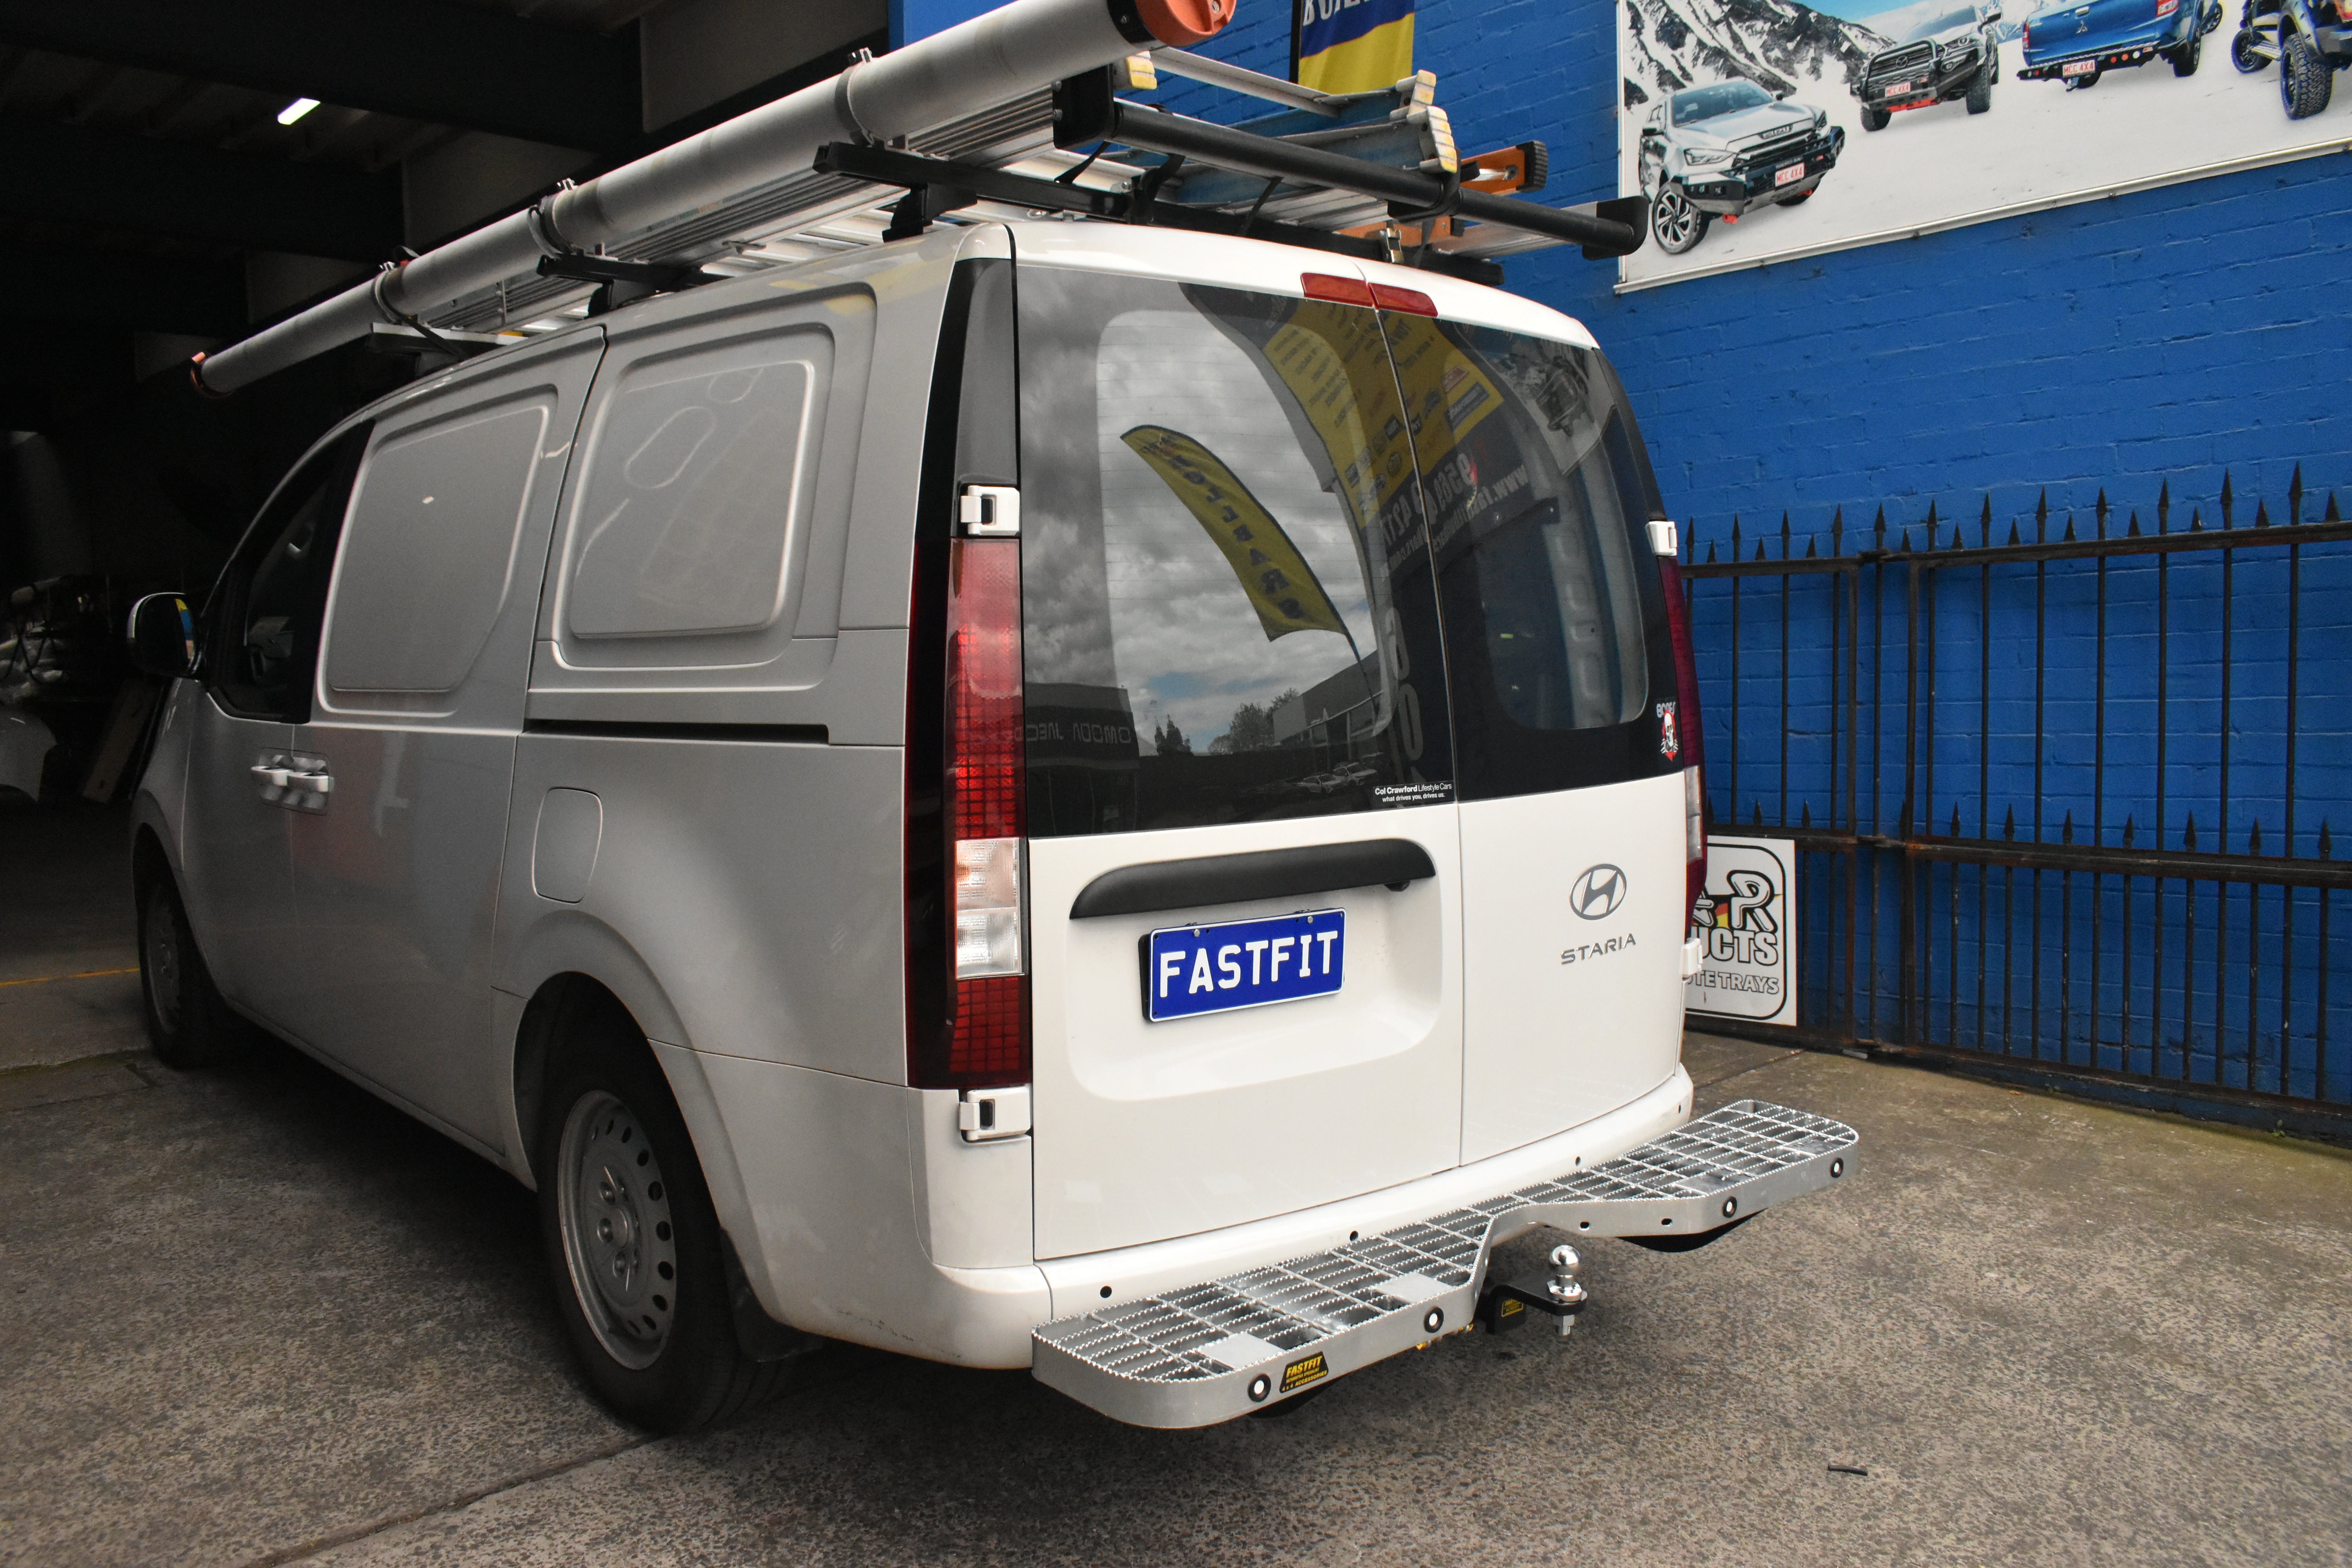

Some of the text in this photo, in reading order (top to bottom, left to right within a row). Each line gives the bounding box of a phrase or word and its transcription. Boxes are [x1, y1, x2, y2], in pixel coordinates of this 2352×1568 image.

[2063, 61, 2094, 74] MCC 4X4
[1898, 83, 1909, 93] 4X4
[1791, 167, 1802, 178] 4X4
[1387, 785, 1417, 795] Crawford
[1418, 783, 1439, 792] Lifestyle
[1561, 933, 1636, 965] STARIA
[1160, 930, 1338, 998] FASTFIT
[1718, 971, 1779, 995] TRAYS
[1286, 1355, 1323, 1378] FASTFIT
[1295, 1370, 1328, 1387] ACCESSORIES
